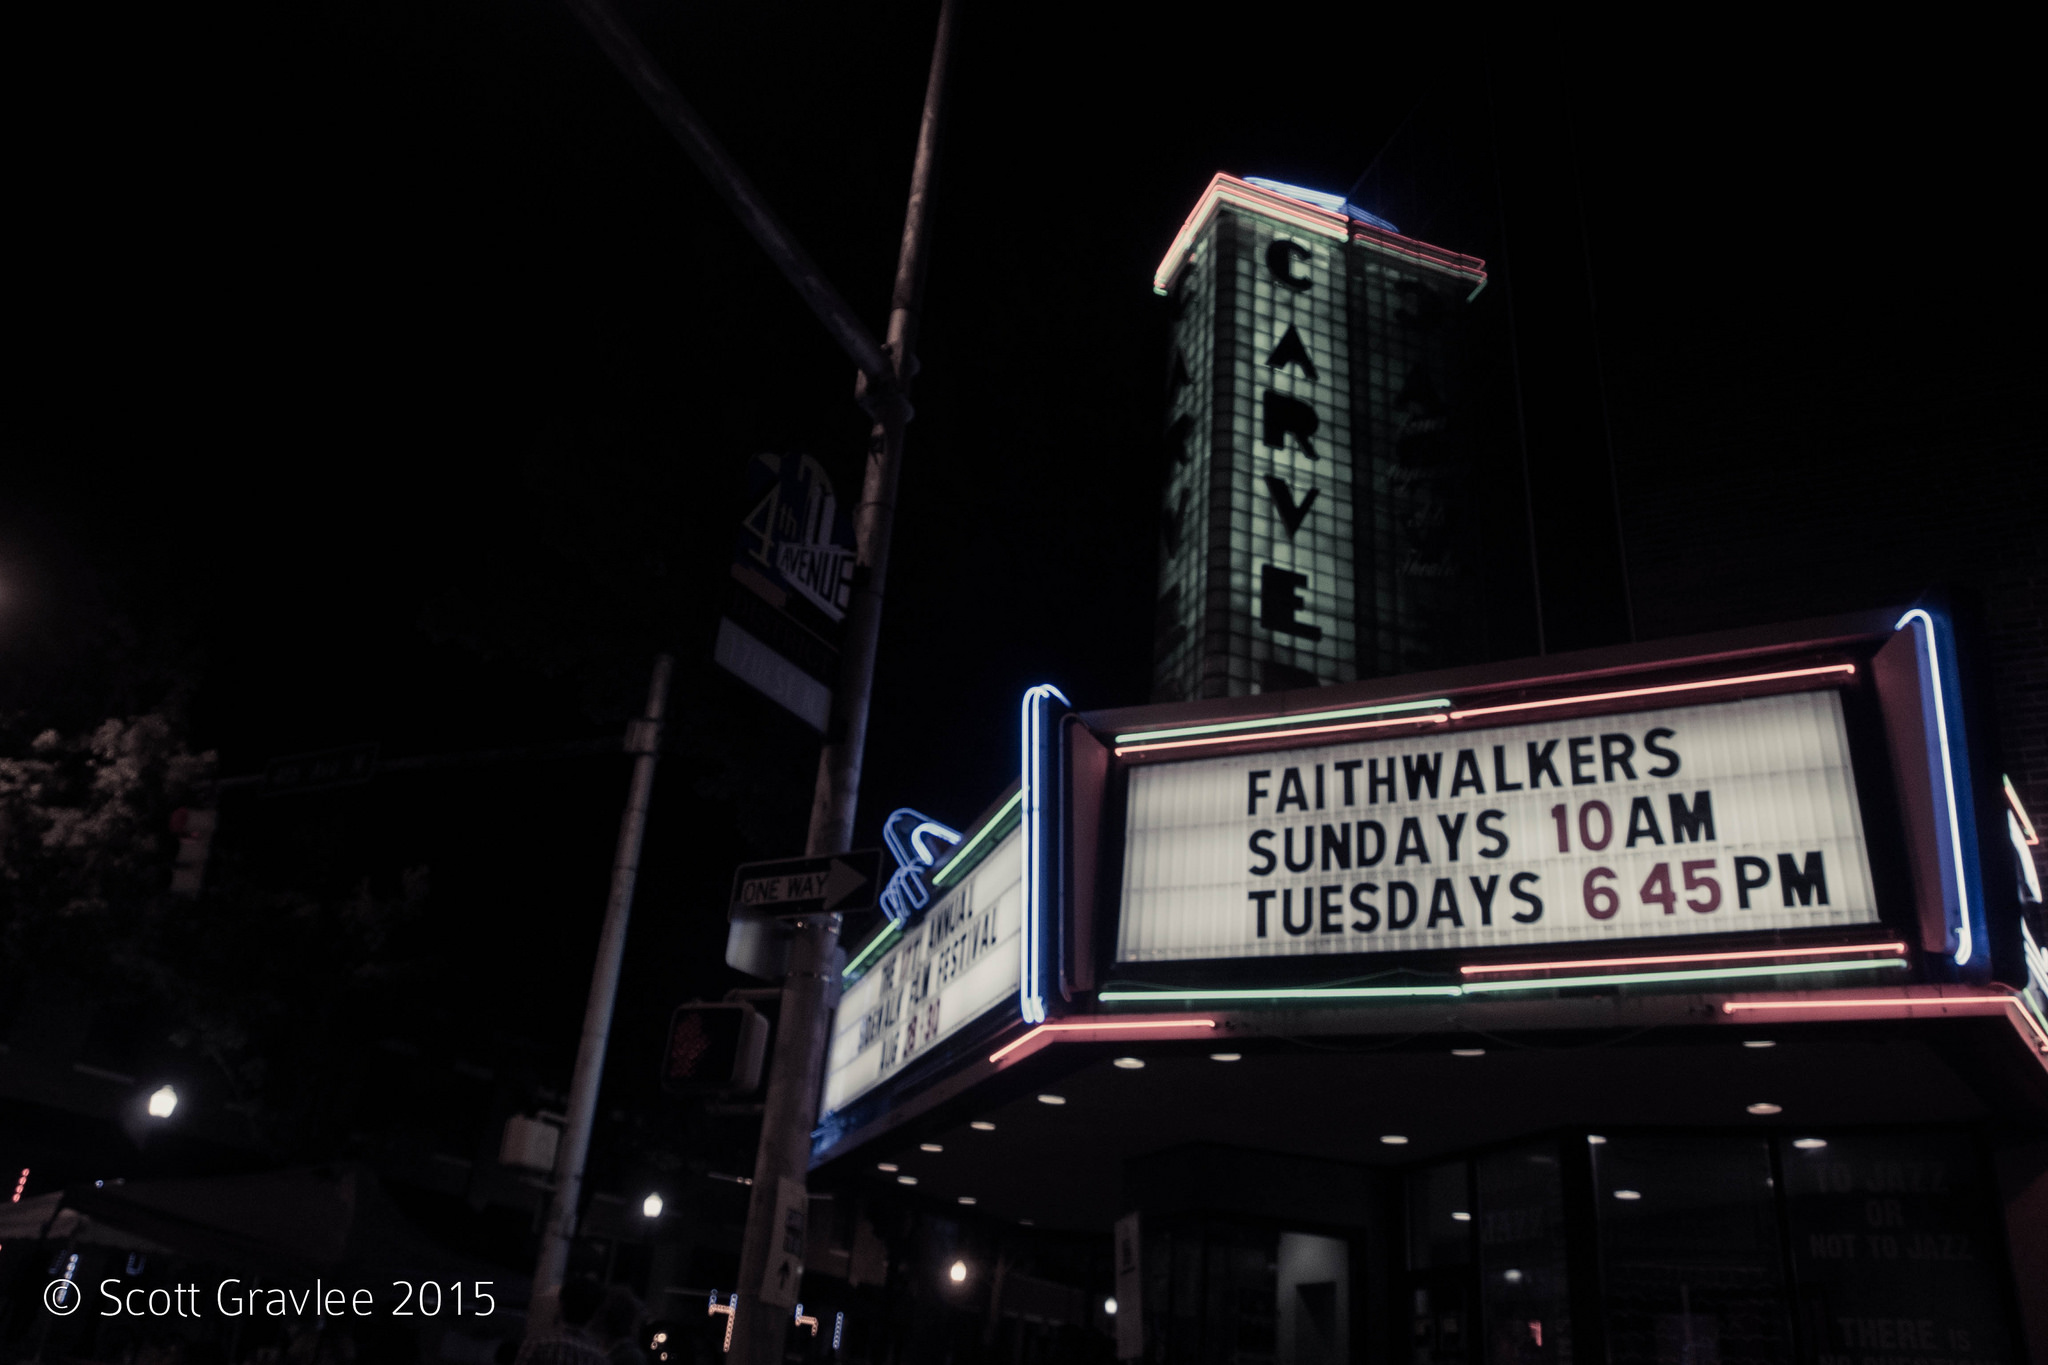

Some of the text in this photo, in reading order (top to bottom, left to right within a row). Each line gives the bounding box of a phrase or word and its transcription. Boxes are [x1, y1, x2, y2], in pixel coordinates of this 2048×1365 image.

[741, 480, 797, 568] 4th
[781, 547, 852, 610] AVENUE
[1247, 728, 1682, 815] FAITHWALKERS
[1248, 809, 1510, 876] SUNDAYS
[743, 873, 828, 904] ONE WAY
[1248, 871, 1544, 938] TUESDAYS
[937, 907, 996, 989] FESTIVAL
[1865, 1199, 1906, 1229] OR
[1808, 1233, 1974, 1261] NOT TO JAZZ
[1836, 1317, 1972, 1352] THERE IS
